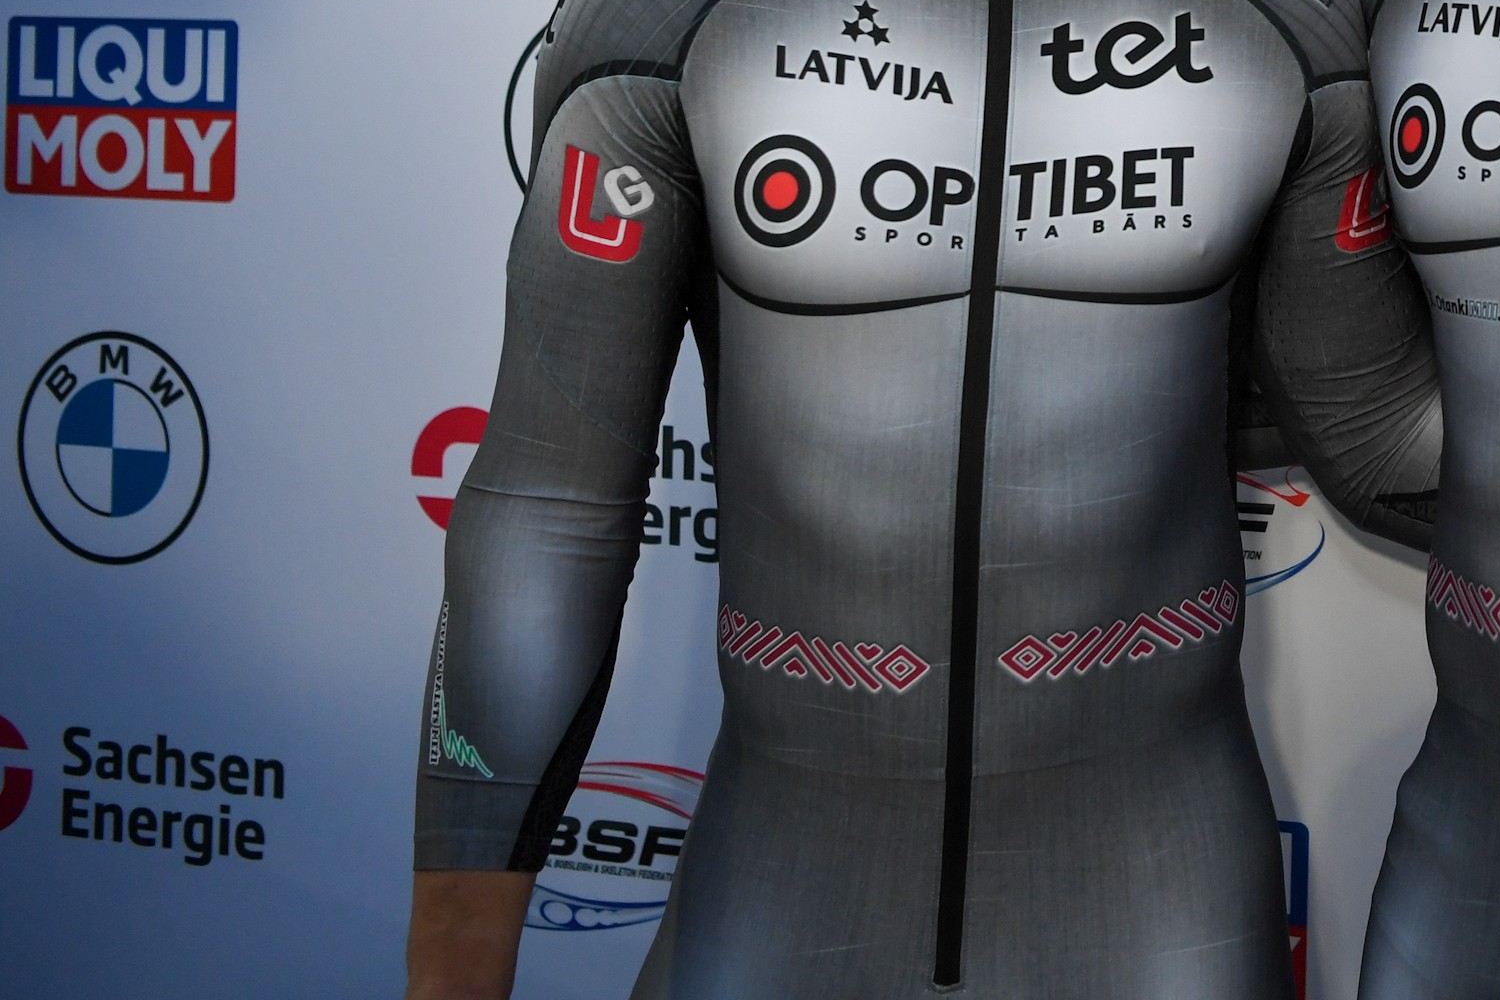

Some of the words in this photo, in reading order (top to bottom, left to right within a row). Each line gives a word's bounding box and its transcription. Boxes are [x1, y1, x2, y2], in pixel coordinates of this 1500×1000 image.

[19, 24, 227, 106] LIQUI
[775, 44, 953, 104] LATVIJA
[1040, 11, 1214, 95] tet
[16, 113, 232, 193] MOLY
[1092, 213, 1193, 234] BĀRS
[45, 344, 184, 408] BMW
[63, 727, 284, 799] Sachsen
[62, 788, 265, 866] Energie
[550, 816, 688, 866] BSF
